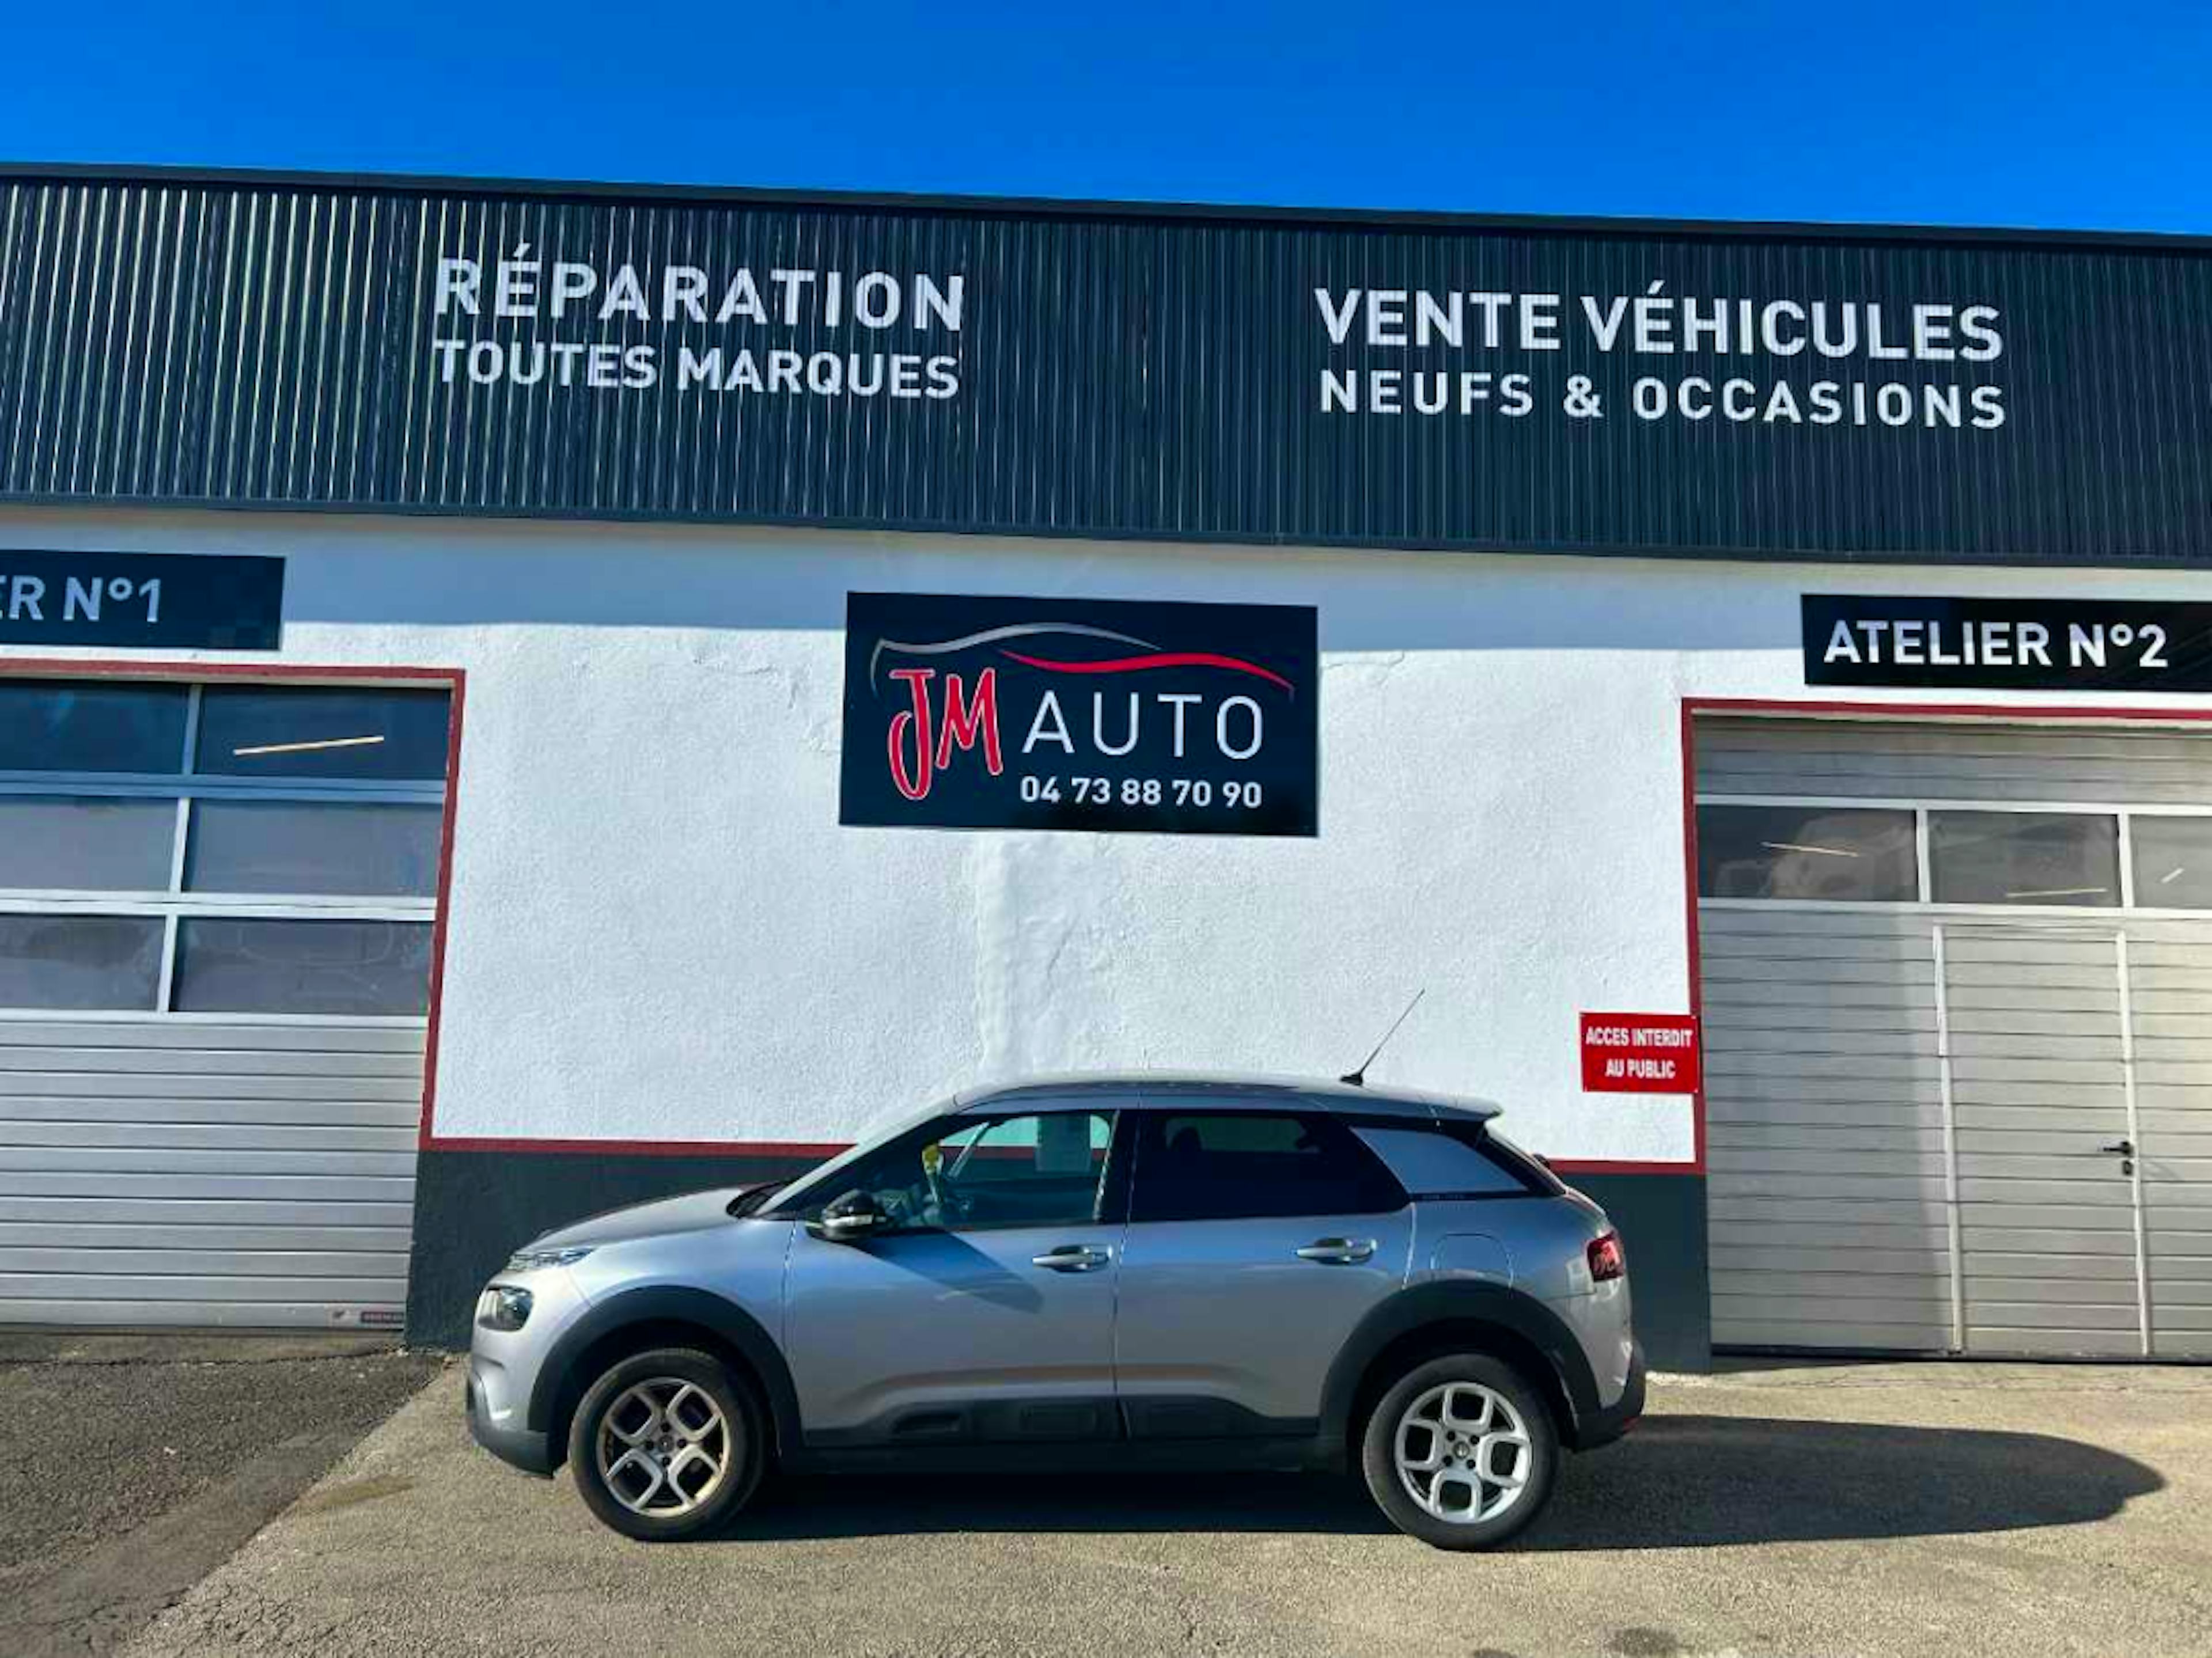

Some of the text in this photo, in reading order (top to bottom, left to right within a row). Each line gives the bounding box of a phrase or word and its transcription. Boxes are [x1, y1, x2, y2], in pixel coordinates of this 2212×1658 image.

[434, 242, 965, 332] RÉPARATION
[1315, 280, 2003, 362] VENTE VÉHICULES
[434, 339, 960, 399] TOUTES MARQUES
[1320, 370, 2006, 430] NEUFS & OCCASIONS
[0, 575, 46, 620] R
[1823, 620, 2052, 666] ATELIER
[888, 667, 1263, 800] JM AUTO
[1020, 775, 1262, 809] 04 73 88 70 90
[1585, 1026, 1693, 1048] ACCES INTERDIT
[1605, 1058, 1676, 1079] AU PUBLIC
